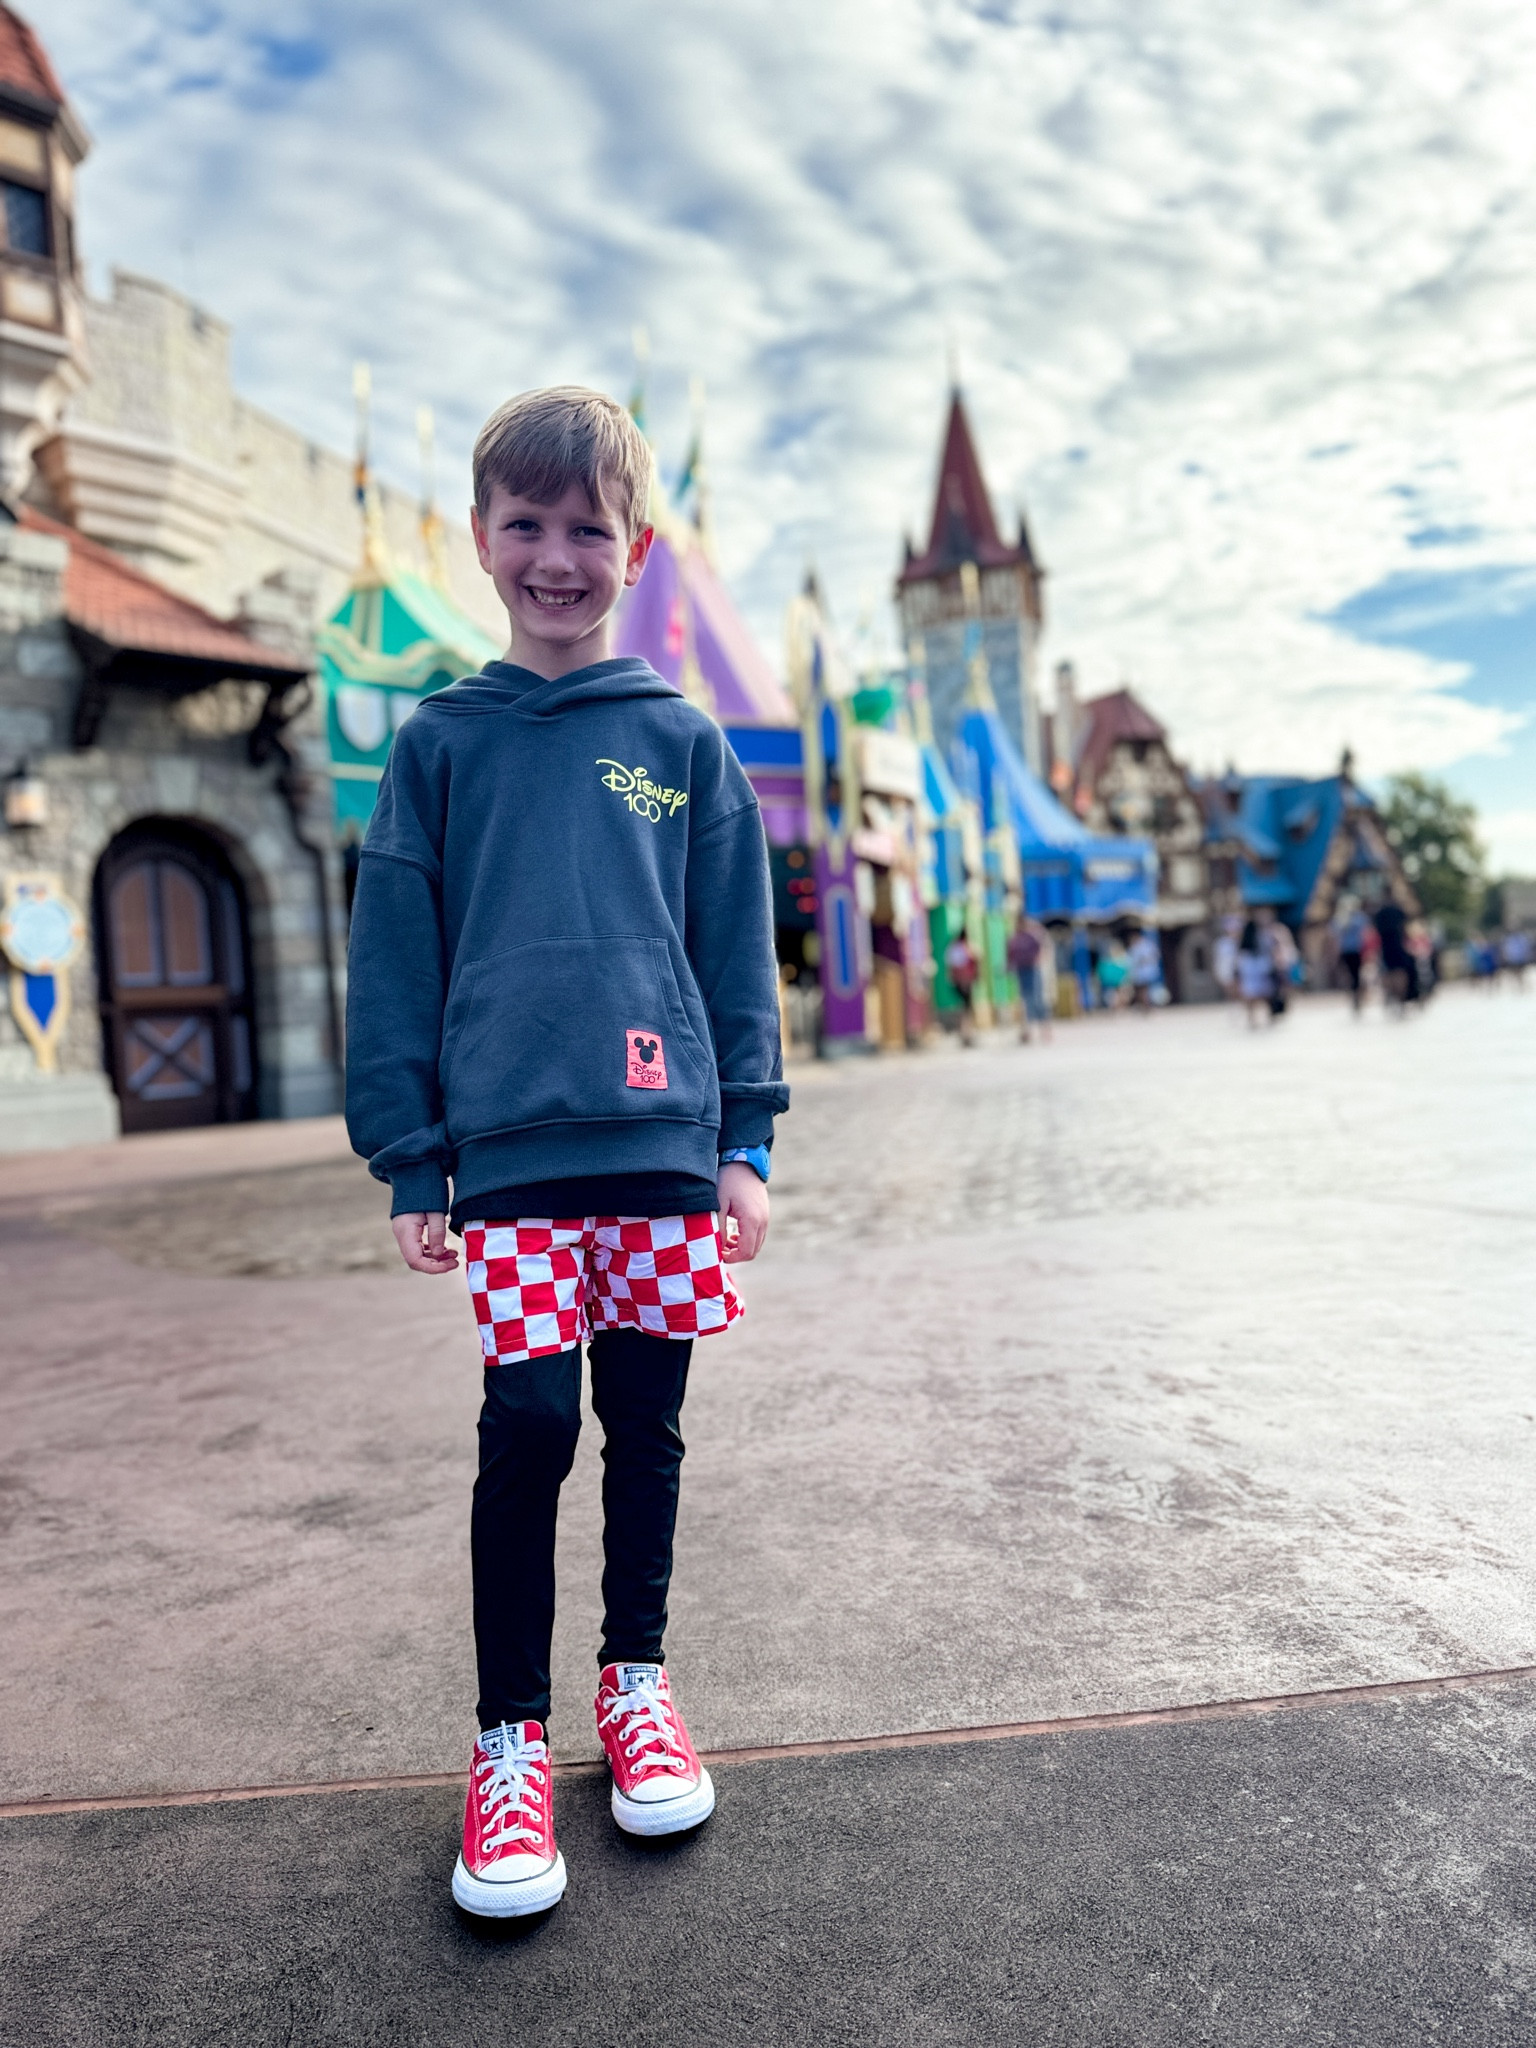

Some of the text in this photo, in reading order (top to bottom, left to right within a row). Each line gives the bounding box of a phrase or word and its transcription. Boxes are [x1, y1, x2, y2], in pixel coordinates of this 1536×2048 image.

[595, 758, 688, 818] Disney
[623, 792, 661, 823] 100
[640, 1075, 656, 1084] 100
[626, 1674, 637, 1686] ALL
[483, 1727, 514, 1740] CONVESE
[499, 1735, 516, 1750] SAR
